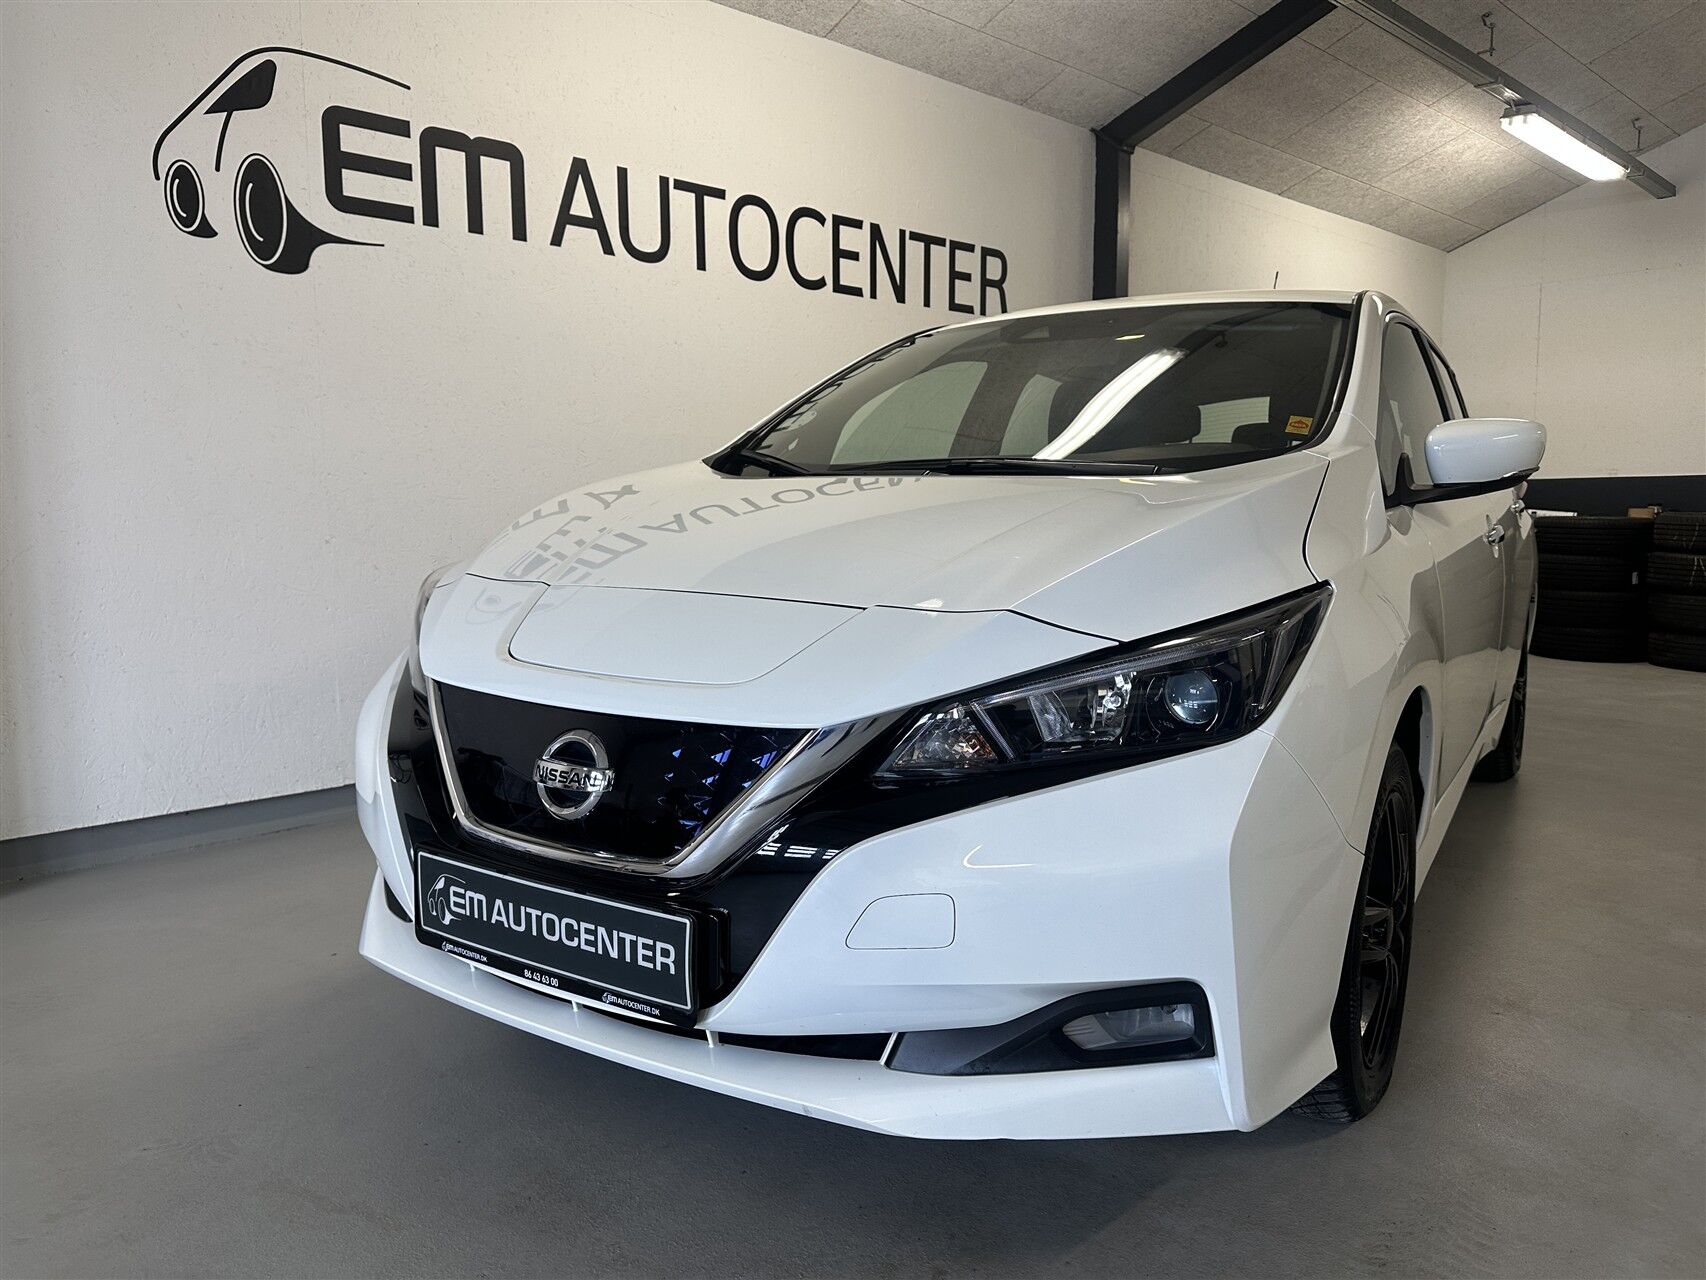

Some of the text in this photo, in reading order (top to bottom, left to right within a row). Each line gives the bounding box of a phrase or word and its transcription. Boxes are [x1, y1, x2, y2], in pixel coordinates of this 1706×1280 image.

[550, 157, 1009, 316] AUTOCENTER
[535, 764, 599, 788] NISSAN
[490, 898, 676, 975] AUTOCENTER
[533, 972, 541, 981] 43
[541, 975, 550, 984] 63
[550, 977, 559, 987] 00
